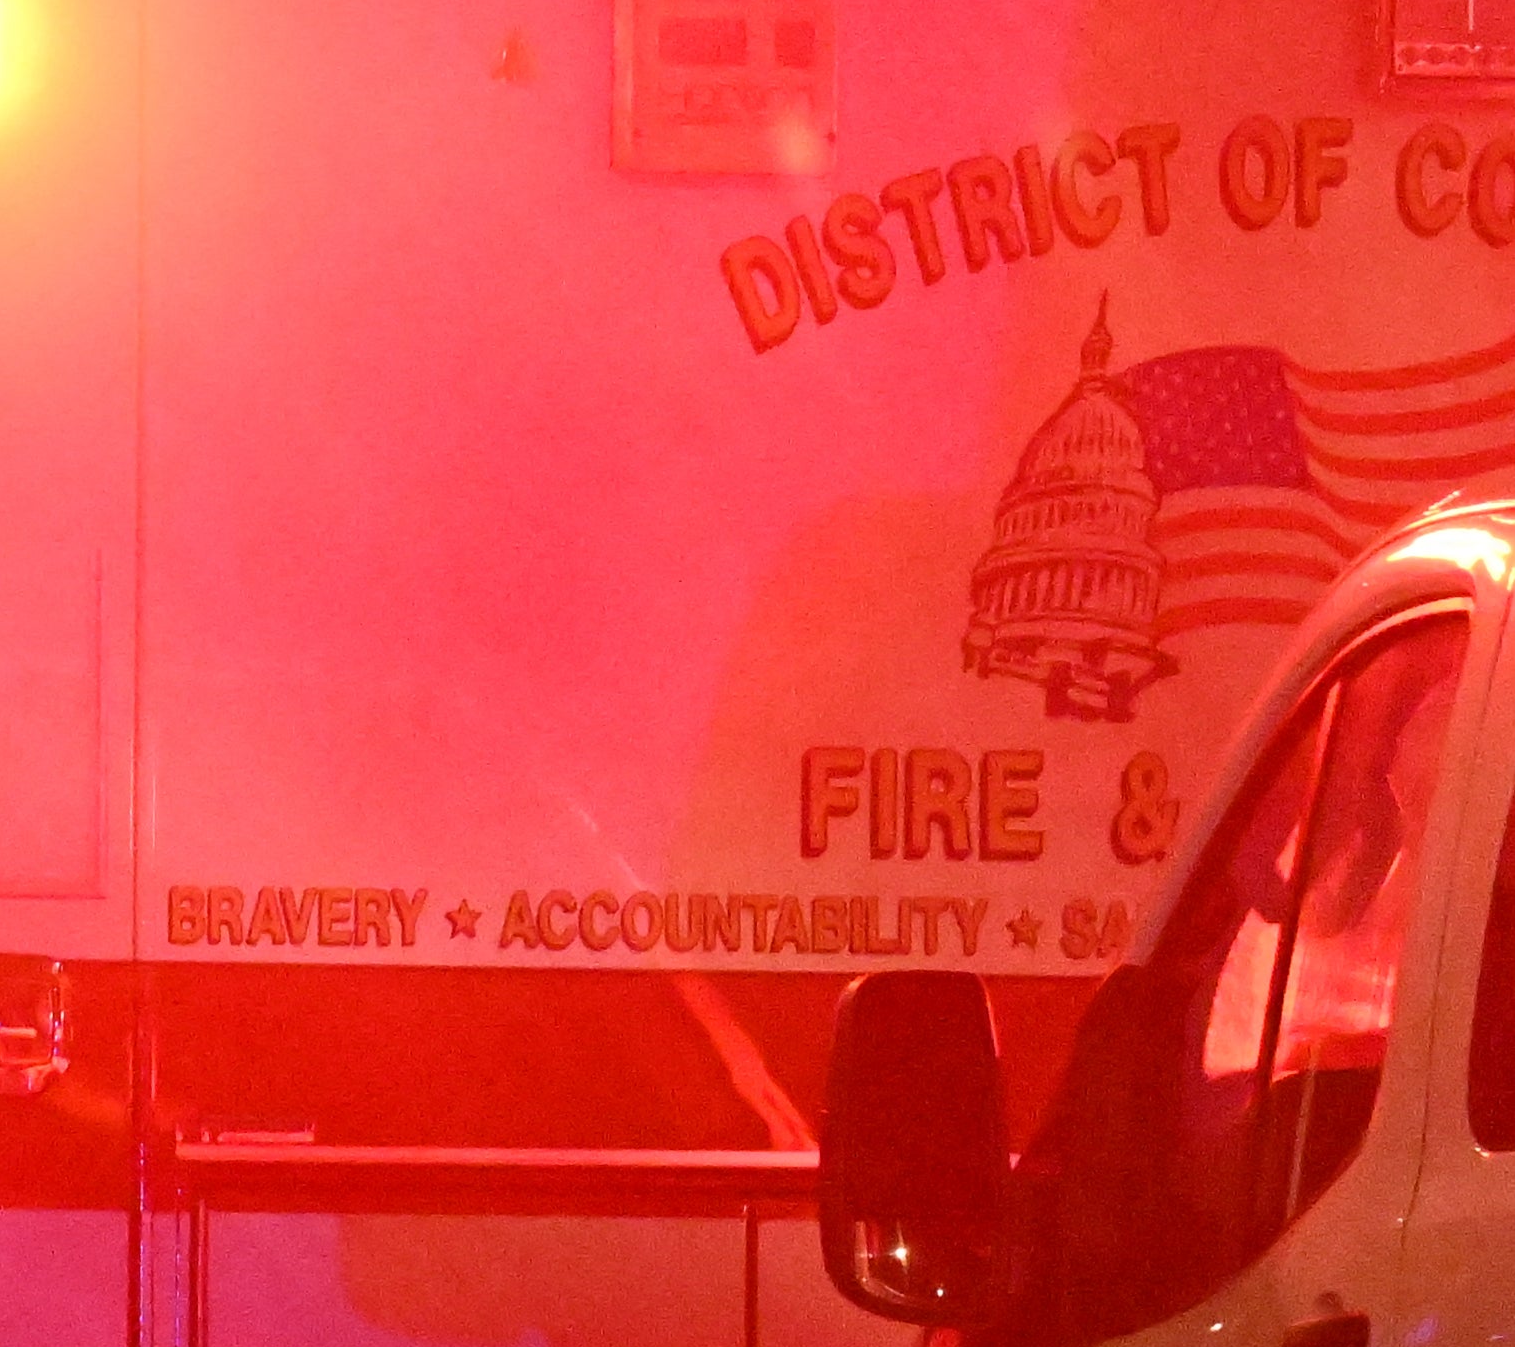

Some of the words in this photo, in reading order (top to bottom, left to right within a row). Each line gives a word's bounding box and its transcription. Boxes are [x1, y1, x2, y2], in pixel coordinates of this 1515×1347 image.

[719, 122, 1181, 354] DISTRICT
[1219, 114, 1353, 232] OF
[800, 747, 1045, 861] FIRE
[1110, 751, 1181, 866] &
[166, 885, 428, 948] BRAVERY
[498, 890, 988, 956] ACCOUNTABILITY
